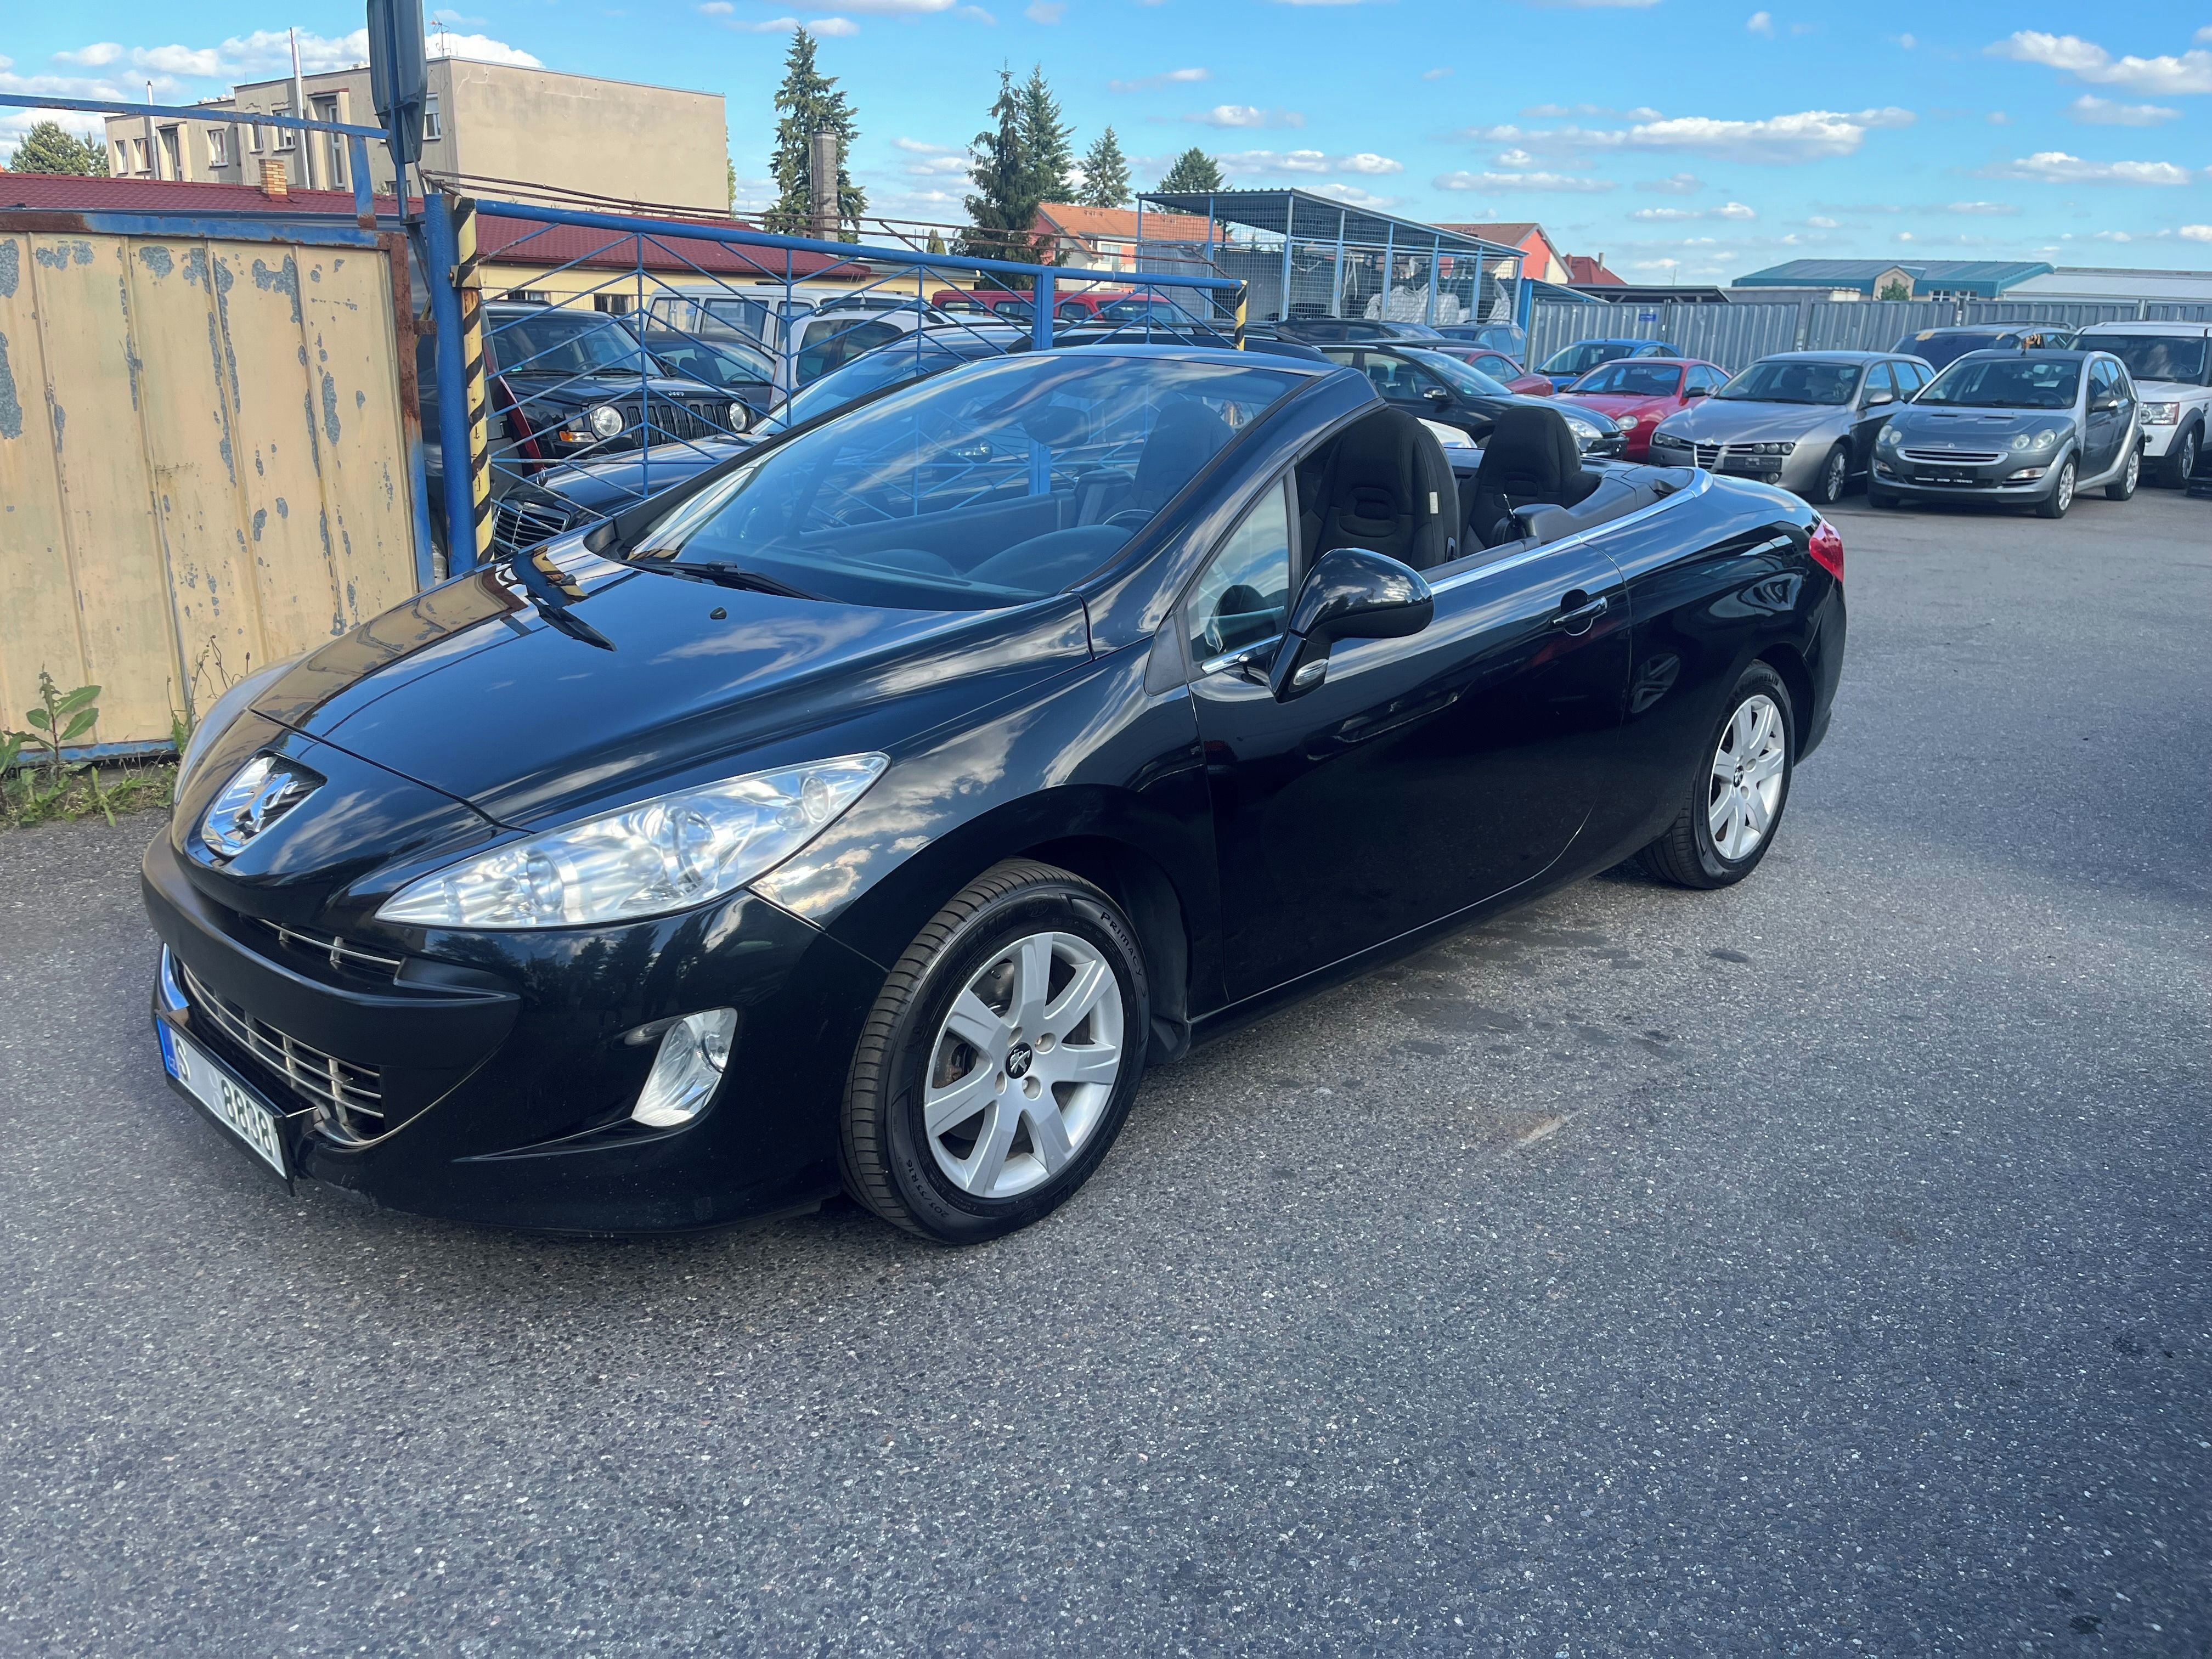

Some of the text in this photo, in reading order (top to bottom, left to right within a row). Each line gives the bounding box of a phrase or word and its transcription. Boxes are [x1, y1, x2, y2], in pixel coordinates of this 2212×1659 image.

[167, 1055, 177, 1071] CZ
[175, 1037, 275, 1158] S 8838
[906, 1159, 950, 1218] 205/55 R16
